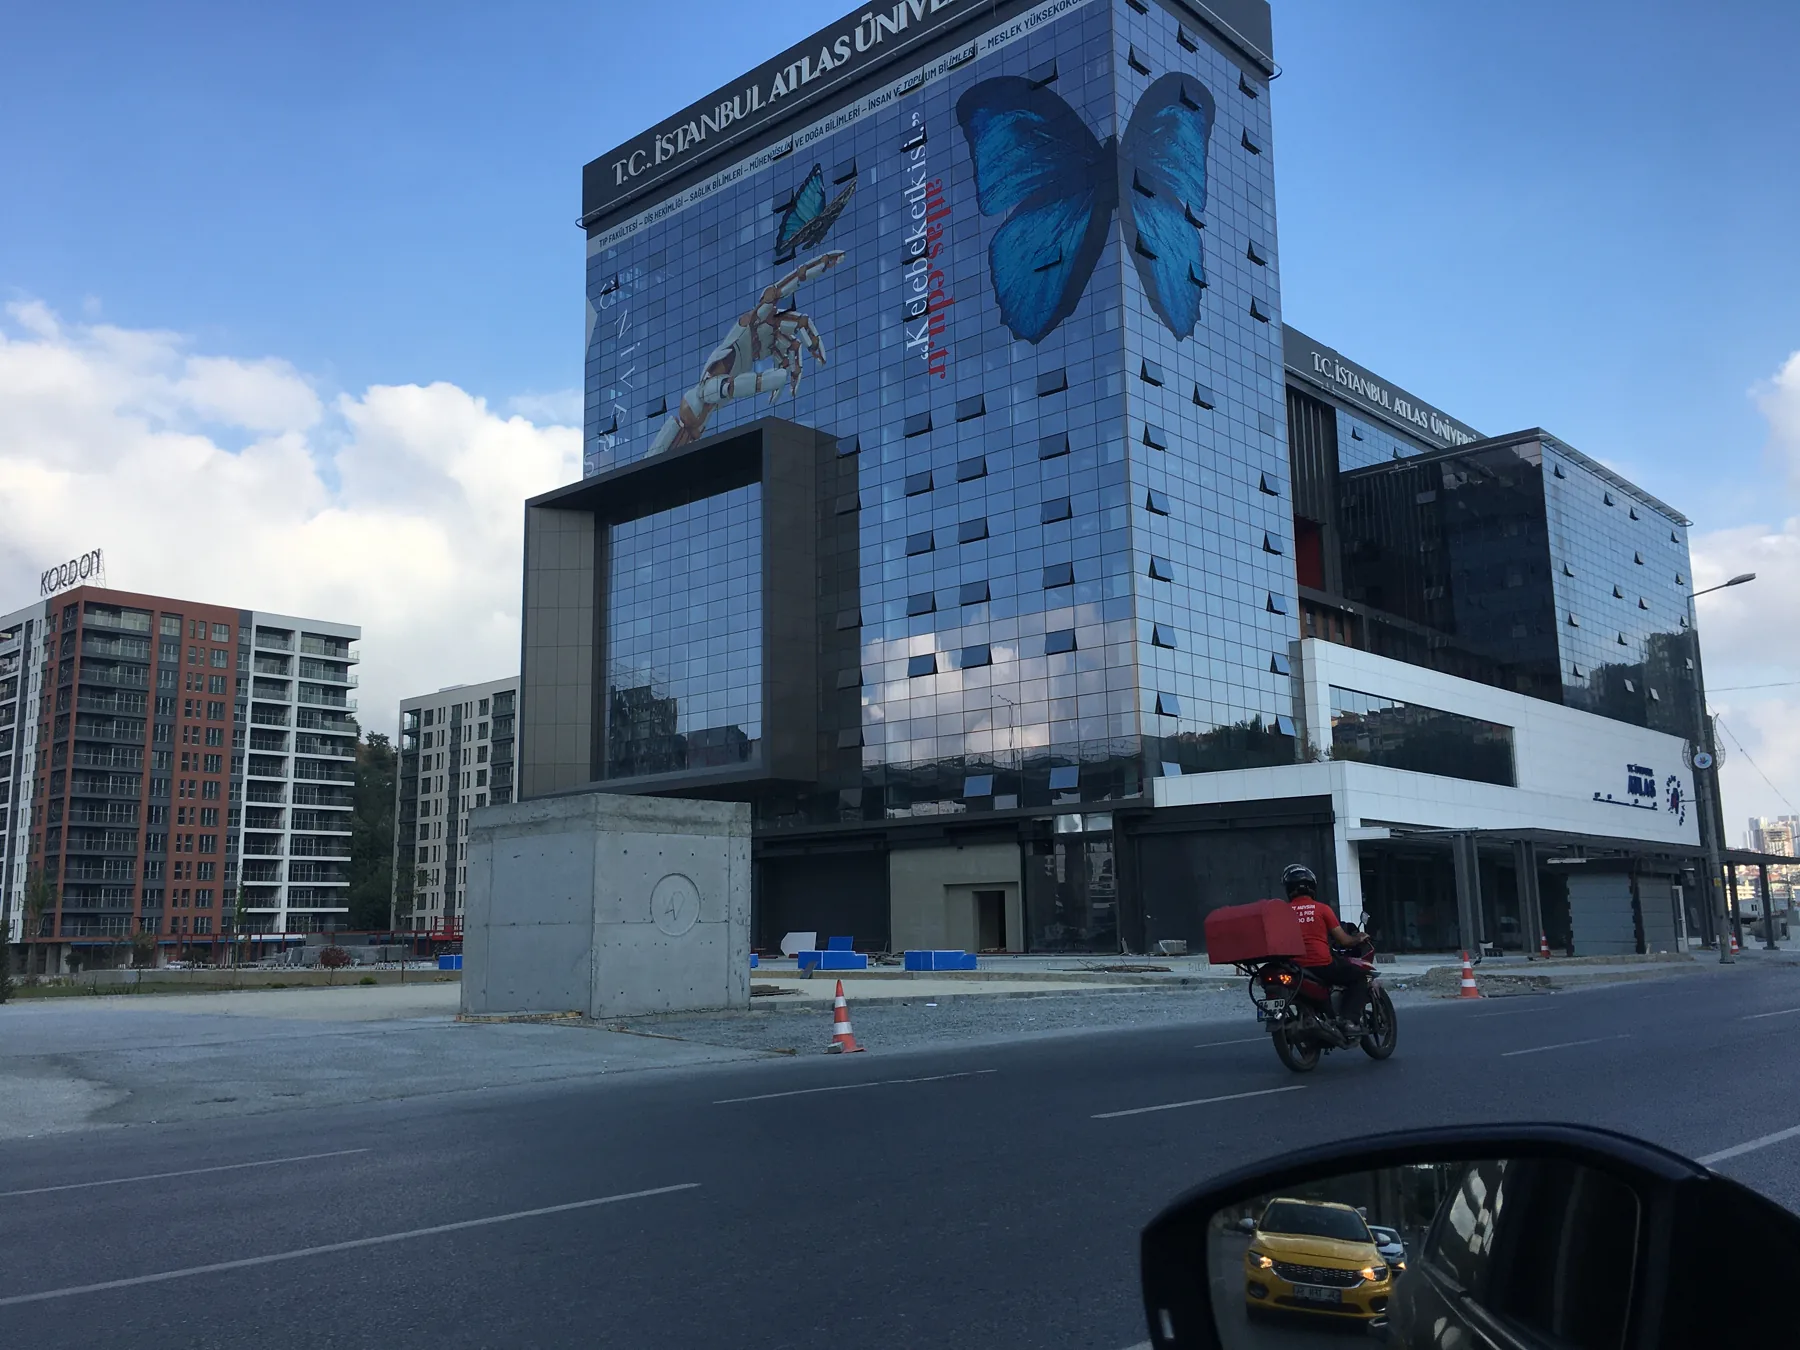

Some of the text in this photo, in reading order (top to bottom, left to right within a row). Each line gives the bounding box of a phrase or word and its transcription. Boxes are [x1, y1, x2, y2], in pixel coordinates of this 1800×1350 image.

[612, 149, 653, 187] T.C.
[654, 84, 766, 166] İSTANBUL
[768, 35, 852, 104] ATLAS
[794, 136, 805, 148] VE
[804, 127, 824, 143] DOĞA
[825, 105, 861, 133] BİLİMLERİ
[868, 90, 892, 111] İNSAN
[987, 22, 1022, 49] MESLEK
[1334, 358, 1392, 410] İSTANBUL
[1393, 397, 1428, 429] ATLAS
